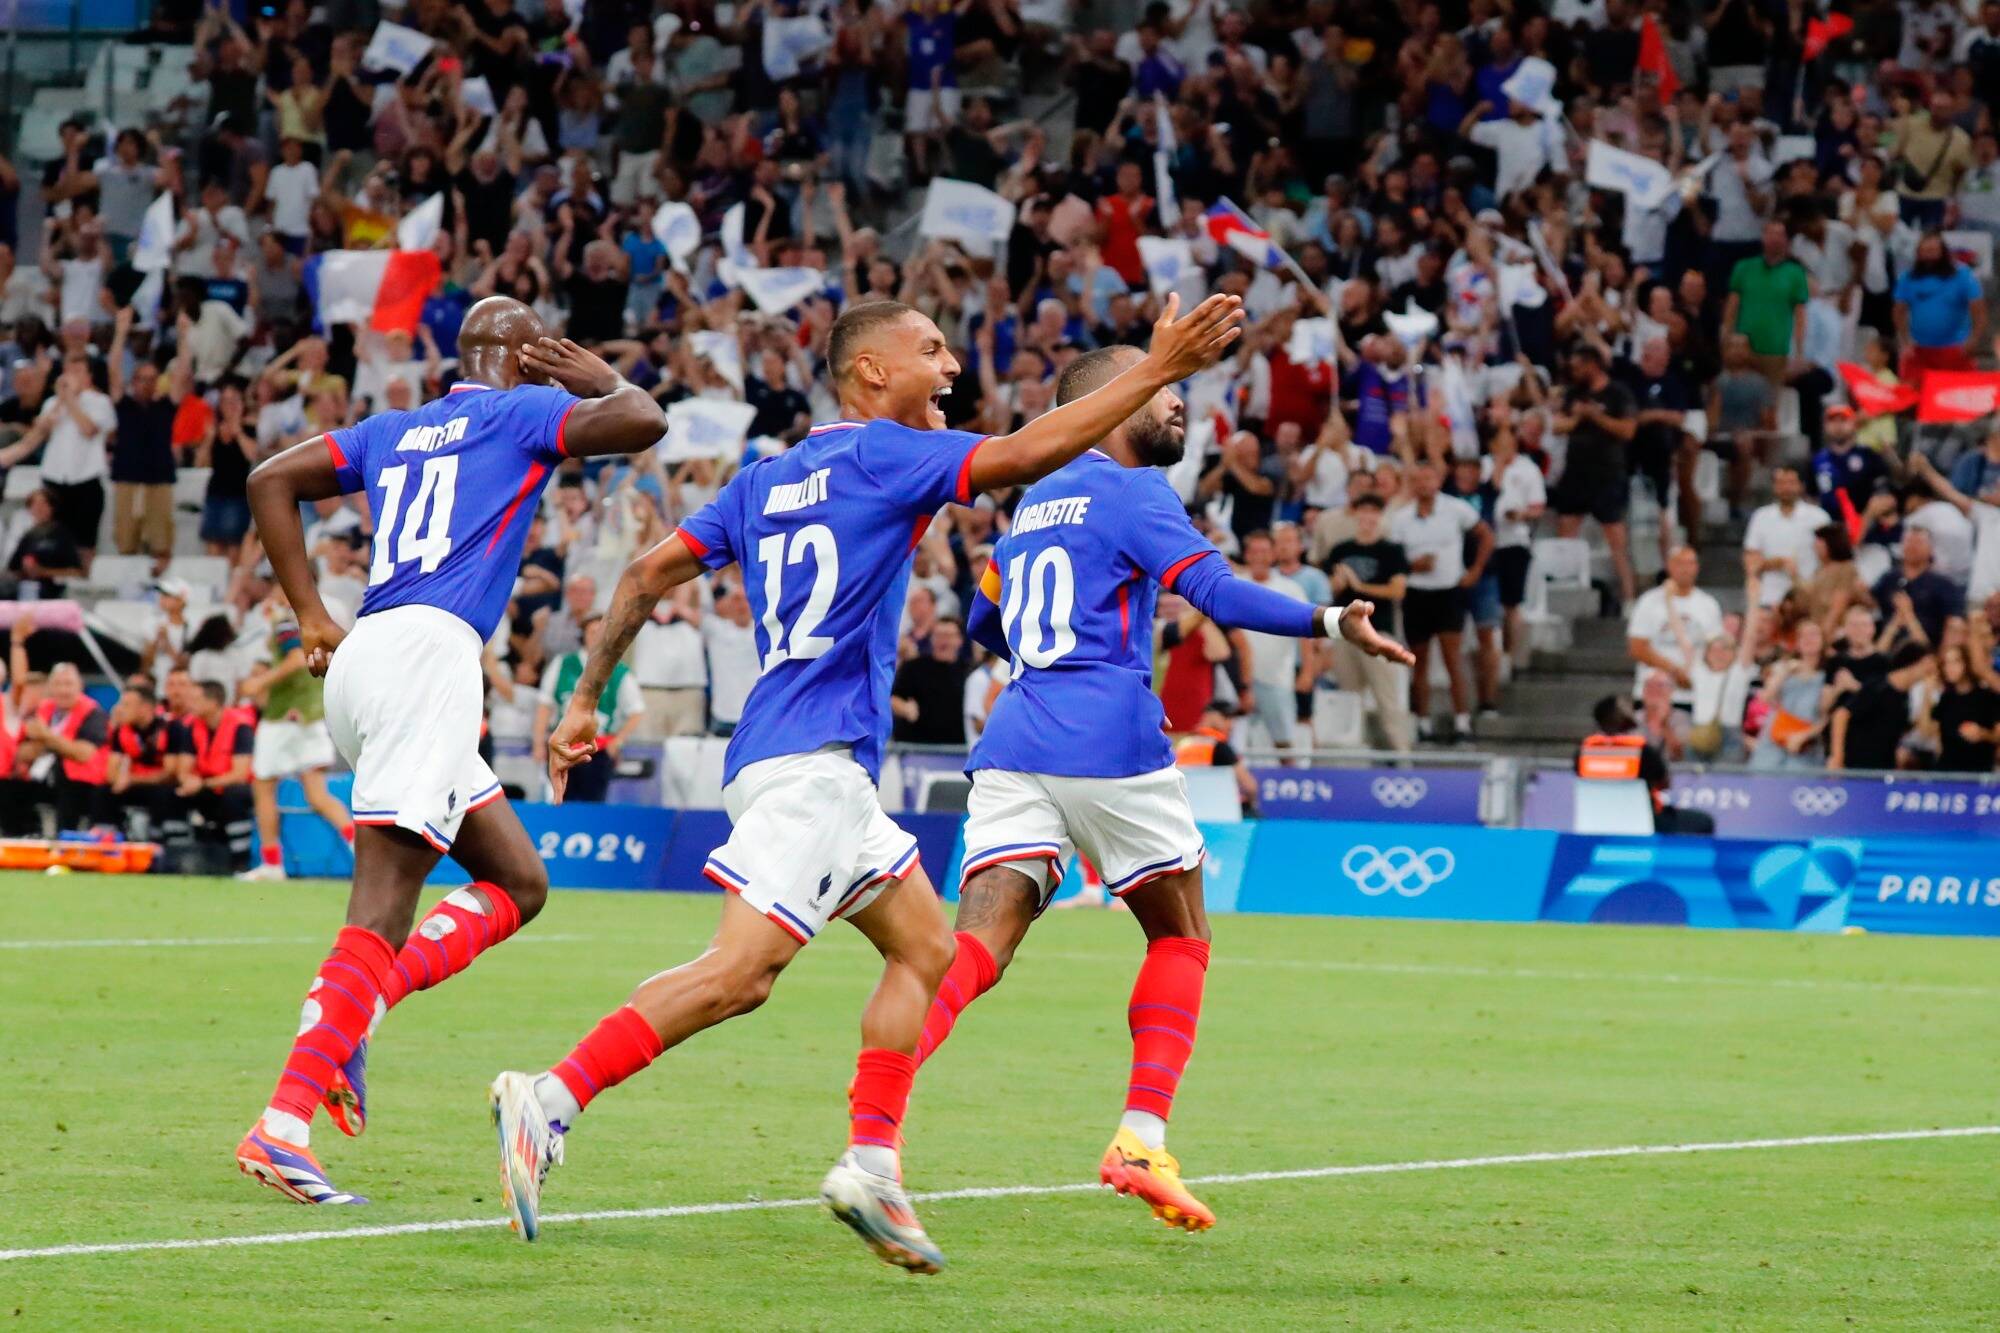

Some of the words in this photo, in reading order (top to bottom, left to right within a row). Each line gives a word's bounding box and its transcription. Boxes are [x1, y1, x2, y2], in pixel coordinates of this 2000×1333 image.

[368, 455, 459, 587] 14
[1011, 496, 1092, 538] LAGAZETTE
[758, 524, 839, 676] 12
[1001, 546, 1076, 680] 10
[1262, 778, 1334, 802] 2024
[1885, 791, 1968, 815] PARIS
[538, 831, 646, 863] 2024
[1877, 874, 2000, 907] PARIS
